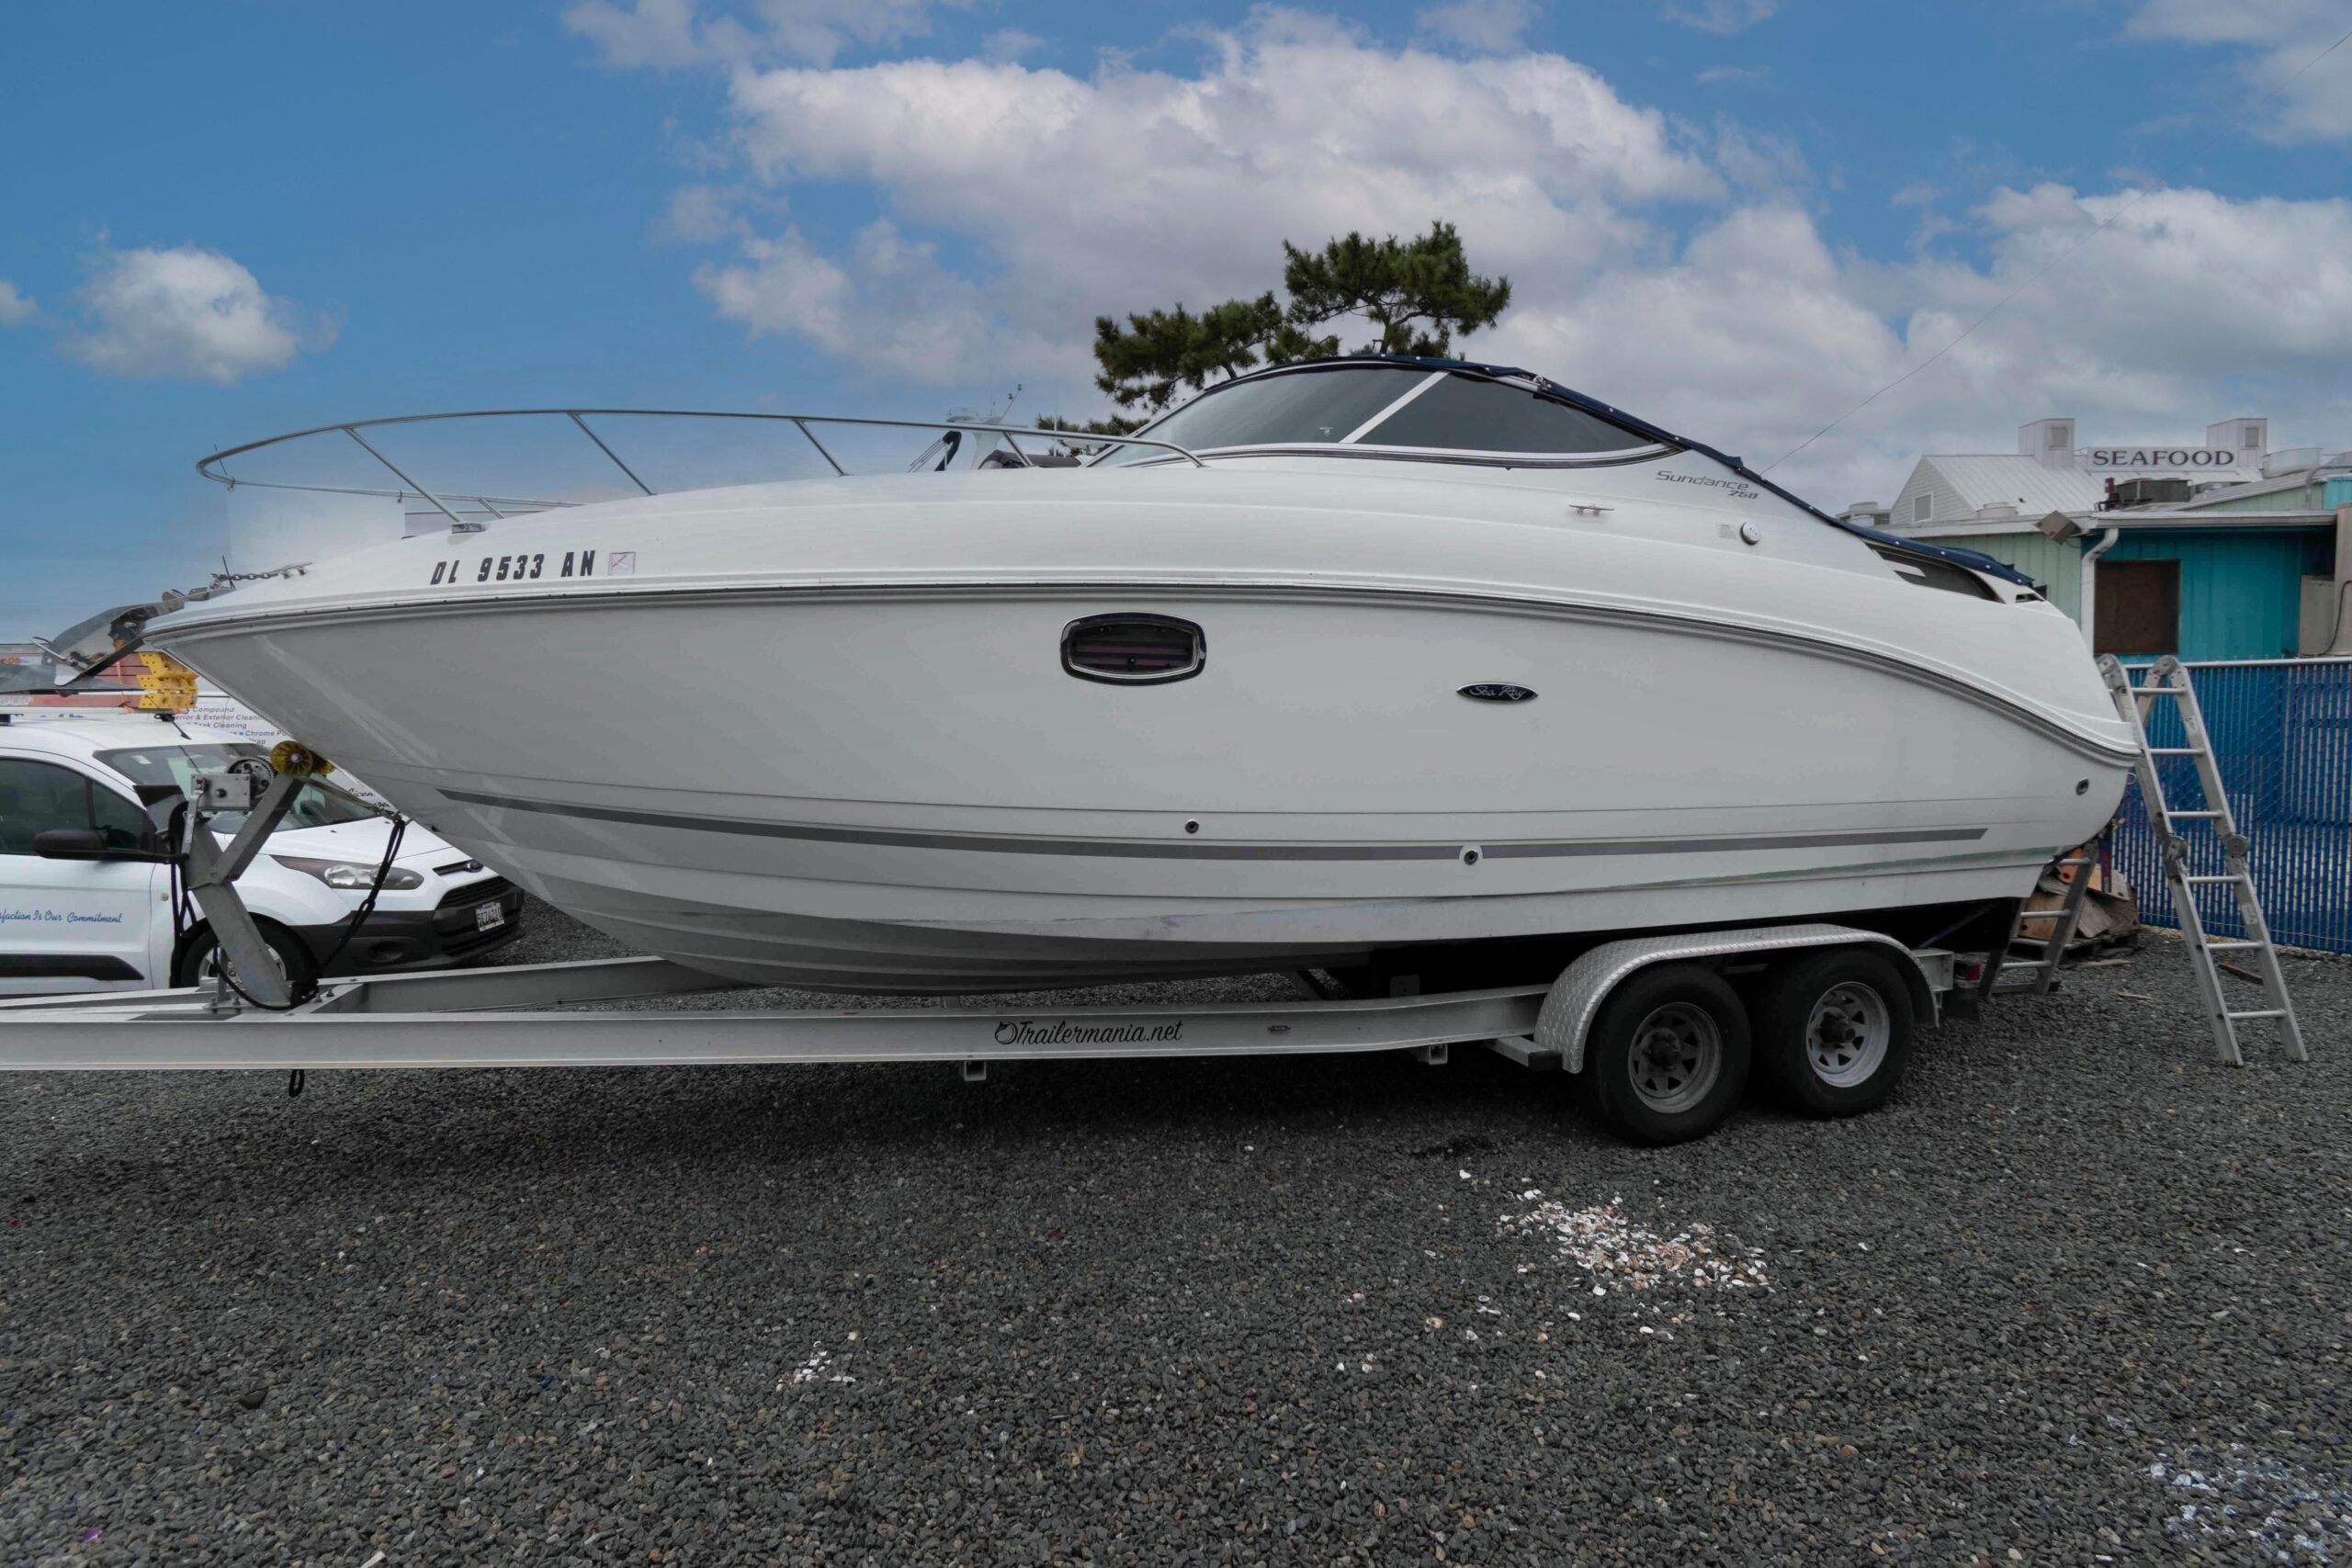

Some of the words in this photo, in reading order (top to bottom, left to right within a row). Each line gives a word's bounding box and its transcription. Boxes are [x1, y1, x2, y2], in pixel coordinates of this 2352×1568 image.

[2092, 449, 2237, 466] SEAFOOD
[430, 560, 460, 585] DL
[477, 553, 545, 582] 9533
[560, 549, 596, 578] AN
[1470, 685, 1496, 696] Sea
[1498, 685, 1527, 701] Ray
[44, 909, 62, 921] Our
[67, 911, 123, 923] Commitment
